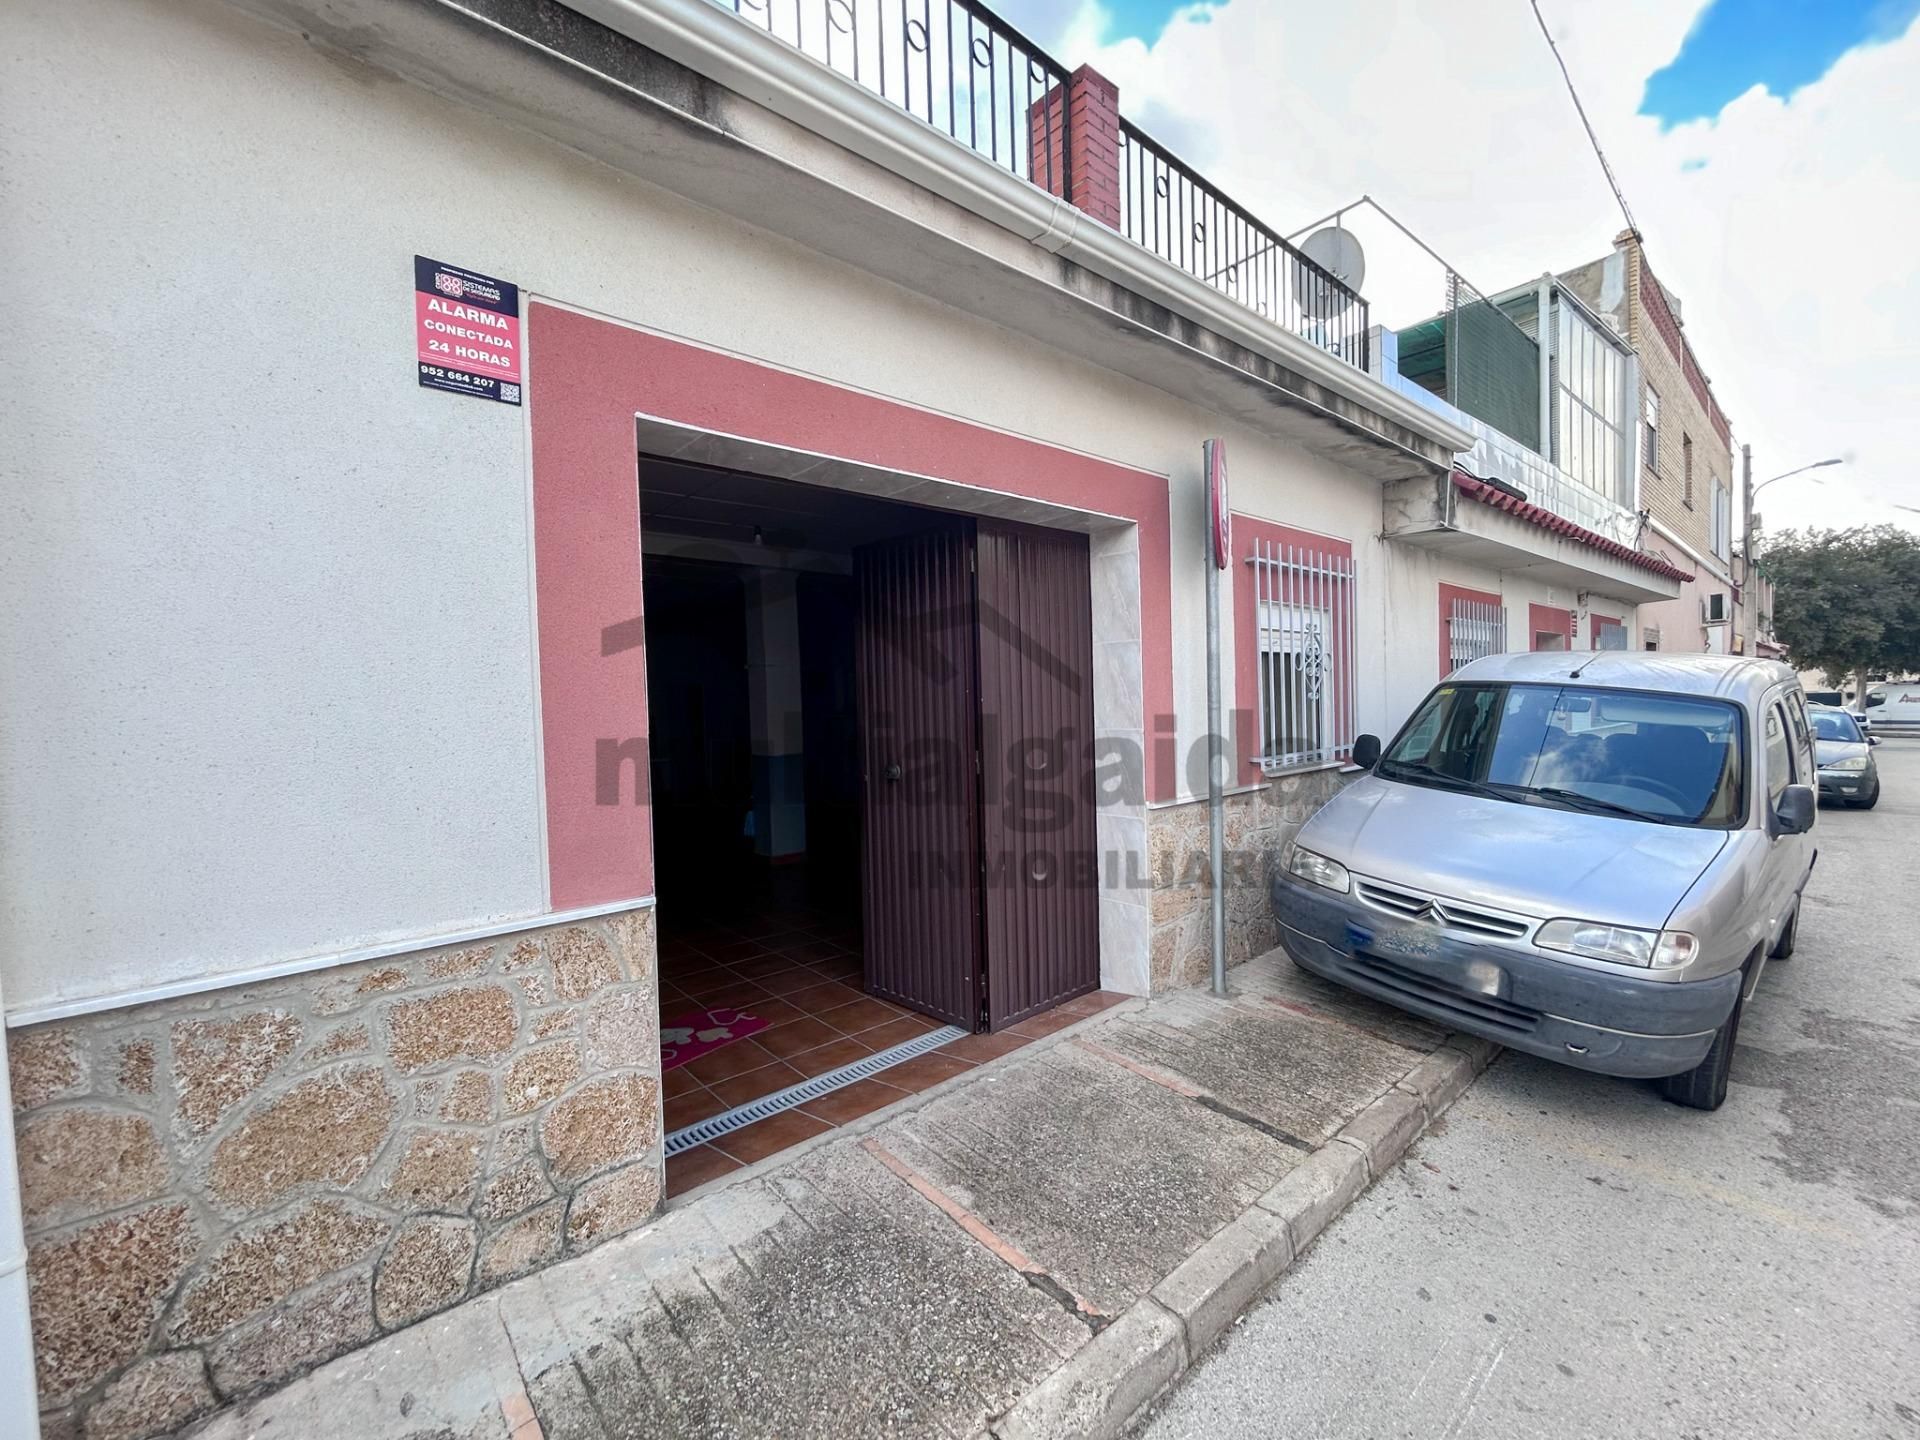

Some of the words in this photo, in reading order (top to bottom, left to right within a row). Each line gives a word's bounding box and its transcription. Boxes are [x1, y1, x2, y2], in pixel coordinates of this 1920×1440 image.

[463, 279, 500, 296] SISTEMAS
[427, 298, 509, 330] ALARMA
[424, 319, 513, 350] CONECTADA
[428, 339, 450, 353] 24
[455, 345, 511, 368] HORAS
[420, 365, 444, 377] 952
[447, 371, 470, 383] 664
[473, 376, 495, 388] 207
